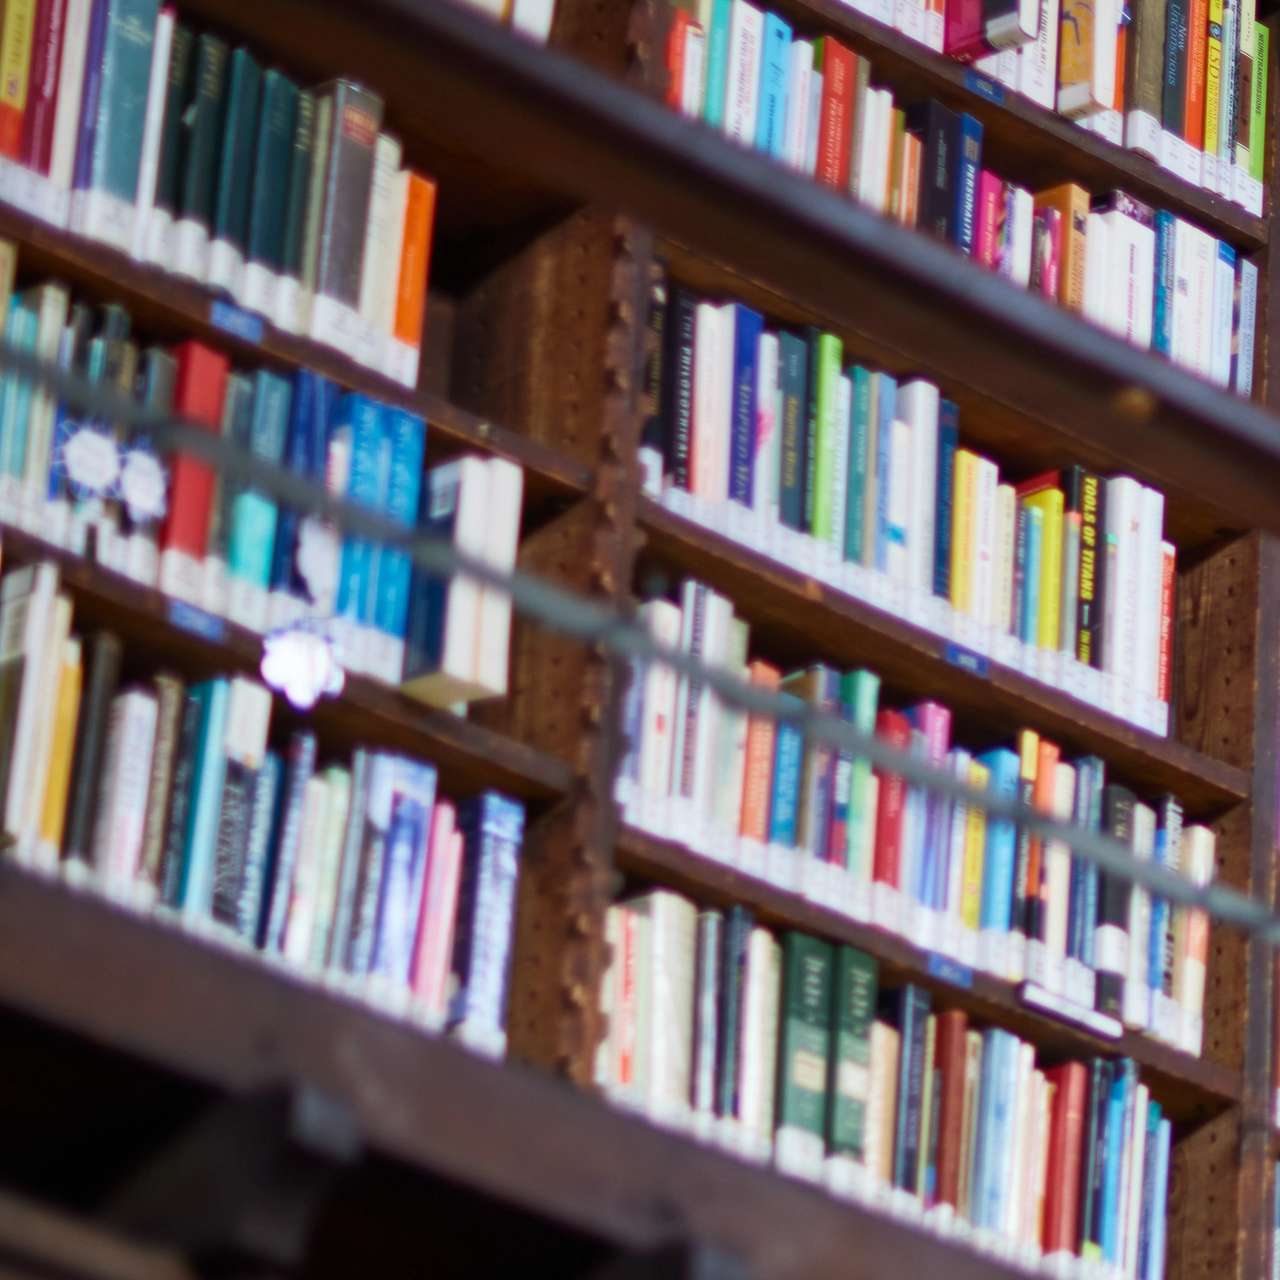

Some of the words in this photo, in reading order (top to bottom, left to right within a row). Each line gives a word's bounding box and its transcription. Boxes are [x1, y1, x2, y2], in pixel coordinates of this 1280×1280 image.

[1084, 478, 1098, 522] TOOLS
[1082, 526, 1096, 546] OF
[1080, 548, 1096, 600] TITANS
